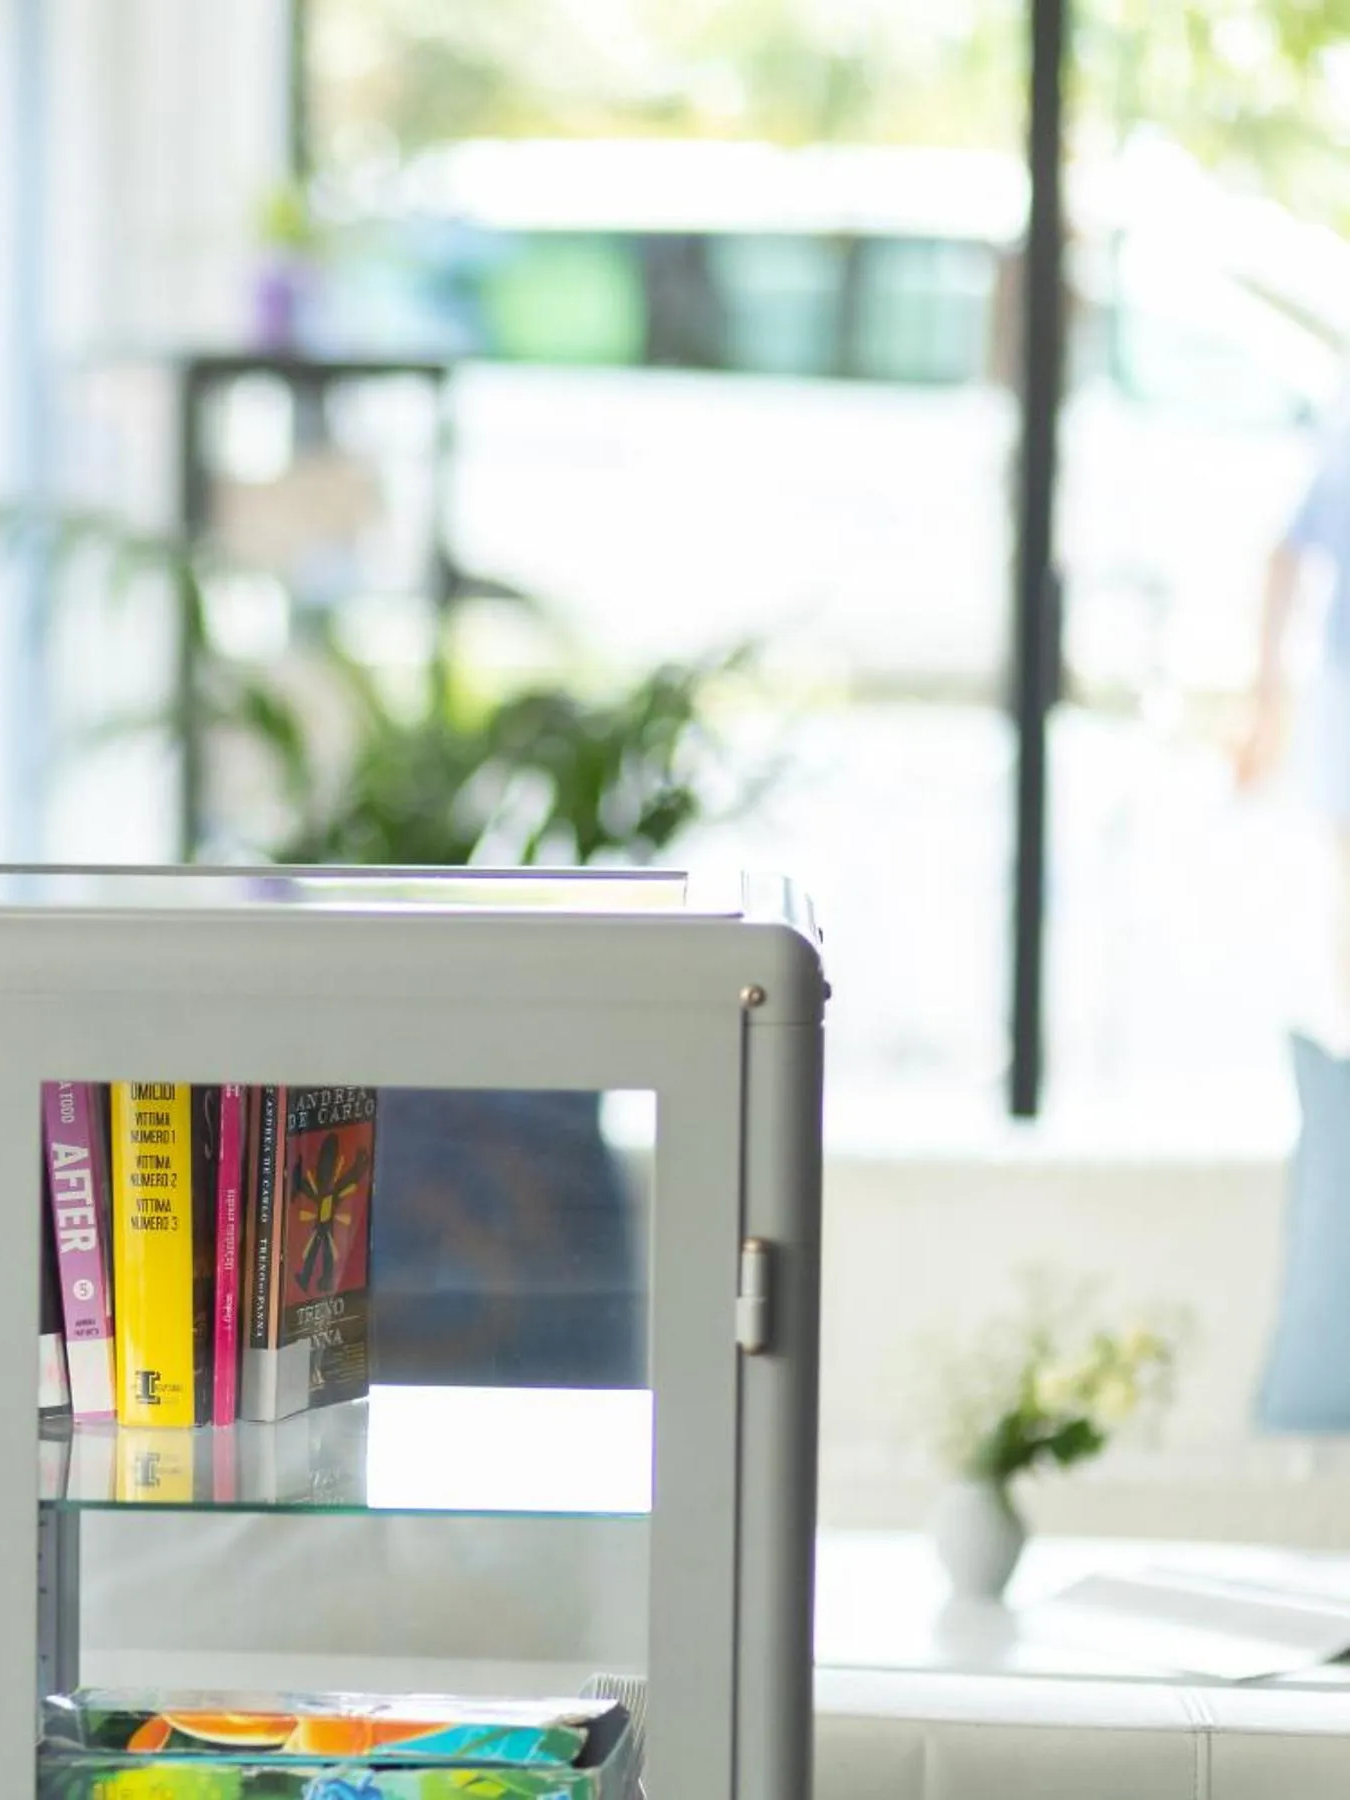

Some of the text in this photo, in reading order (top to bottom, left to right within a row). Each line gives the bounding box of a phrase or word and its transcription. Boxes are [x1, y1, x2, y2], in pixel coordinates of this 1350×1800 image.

[296, 1085, 368, 1112] ANDREA
[60, 1092, 75, 1124] TODD
[289, 1098, 375, 1130] DE CARLO
[135, 1111, 170, 1126] VITTIMA
[263, 1099, 274, 1152] ANDREA
[130, 1130, 176, 1144] NUMERO 1
[136, 1155, 171, 1169] VITTIMA
[130, 1173, 178, 1188] NUMERO 2
[51, 1142, 98, 1254] AFTER
[136, 1198, 171, 1213] VITTIMA
[130, 1216, 179, 1231] NUMERO 3
